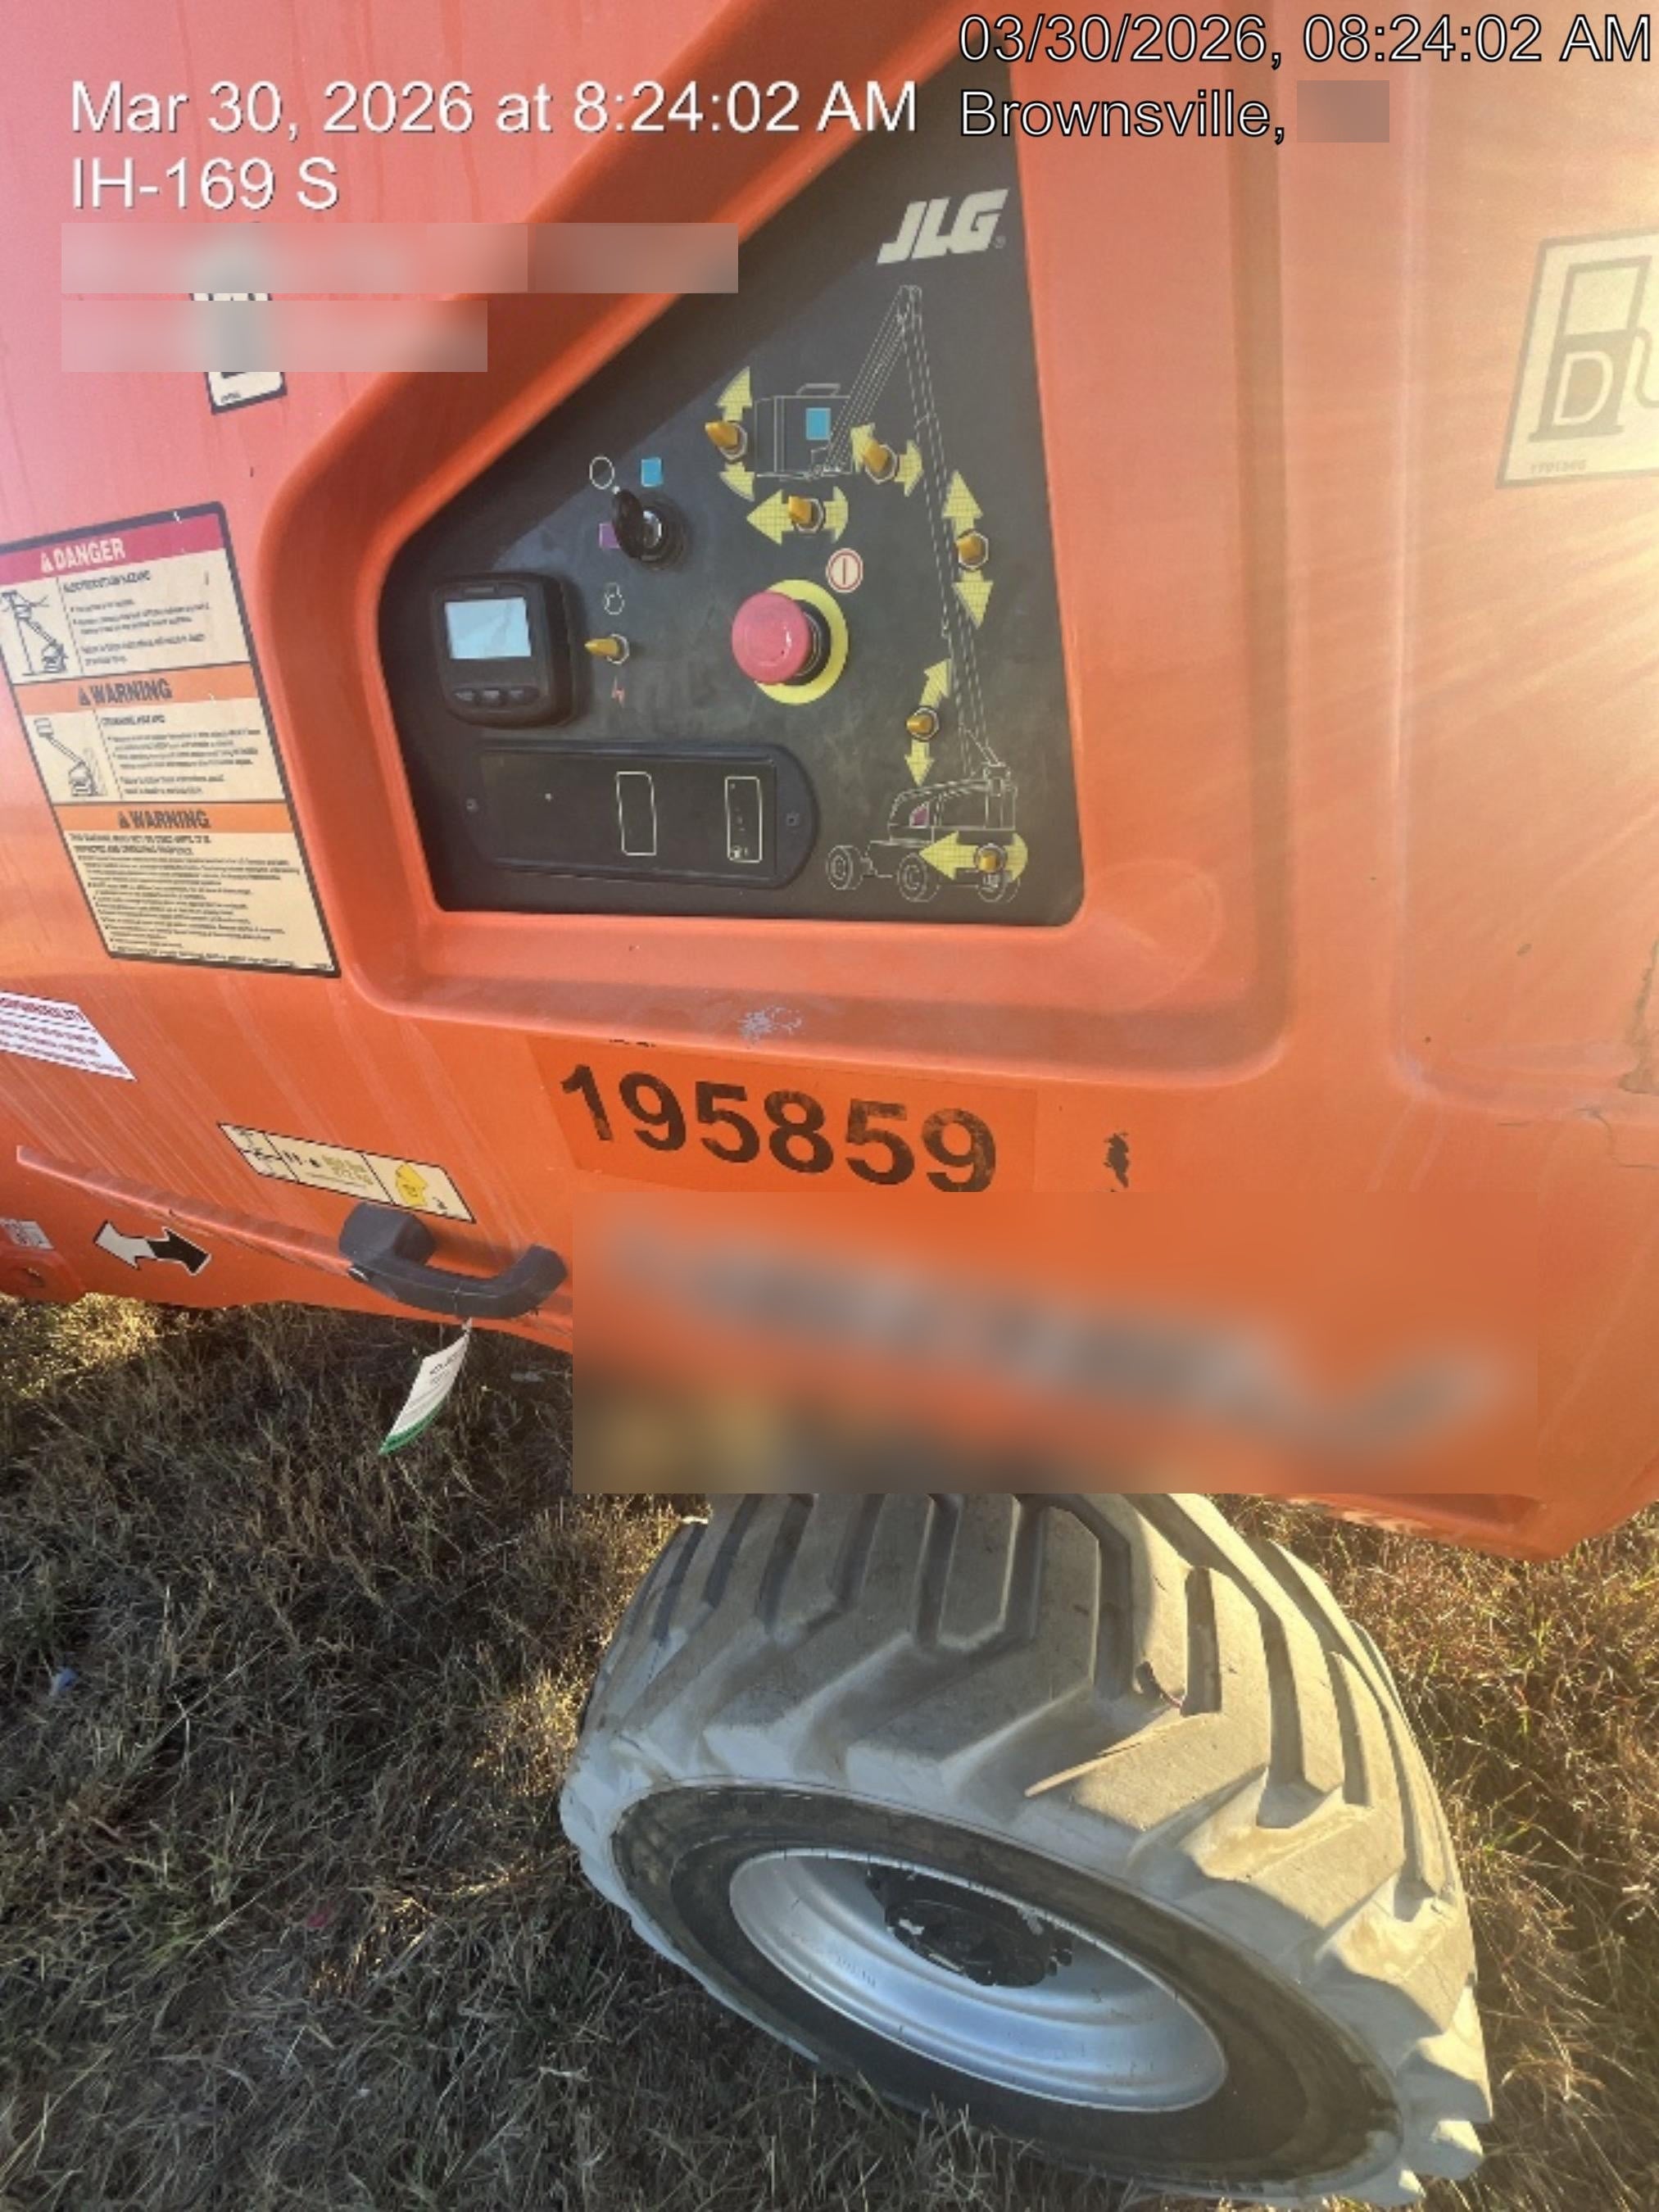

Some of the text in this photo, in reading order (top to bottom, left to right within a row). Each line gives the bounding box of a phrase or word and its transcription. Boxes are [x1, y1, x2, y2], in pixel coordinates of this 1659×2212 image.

[877, 188, 1009, 264] JLG
[52, 537, 126, 571] DANGER
[90, 678, 172, 705] WARNING
[129, 809, 211, 829] WARNING
[560, 1063, 996, 1192] 195859
